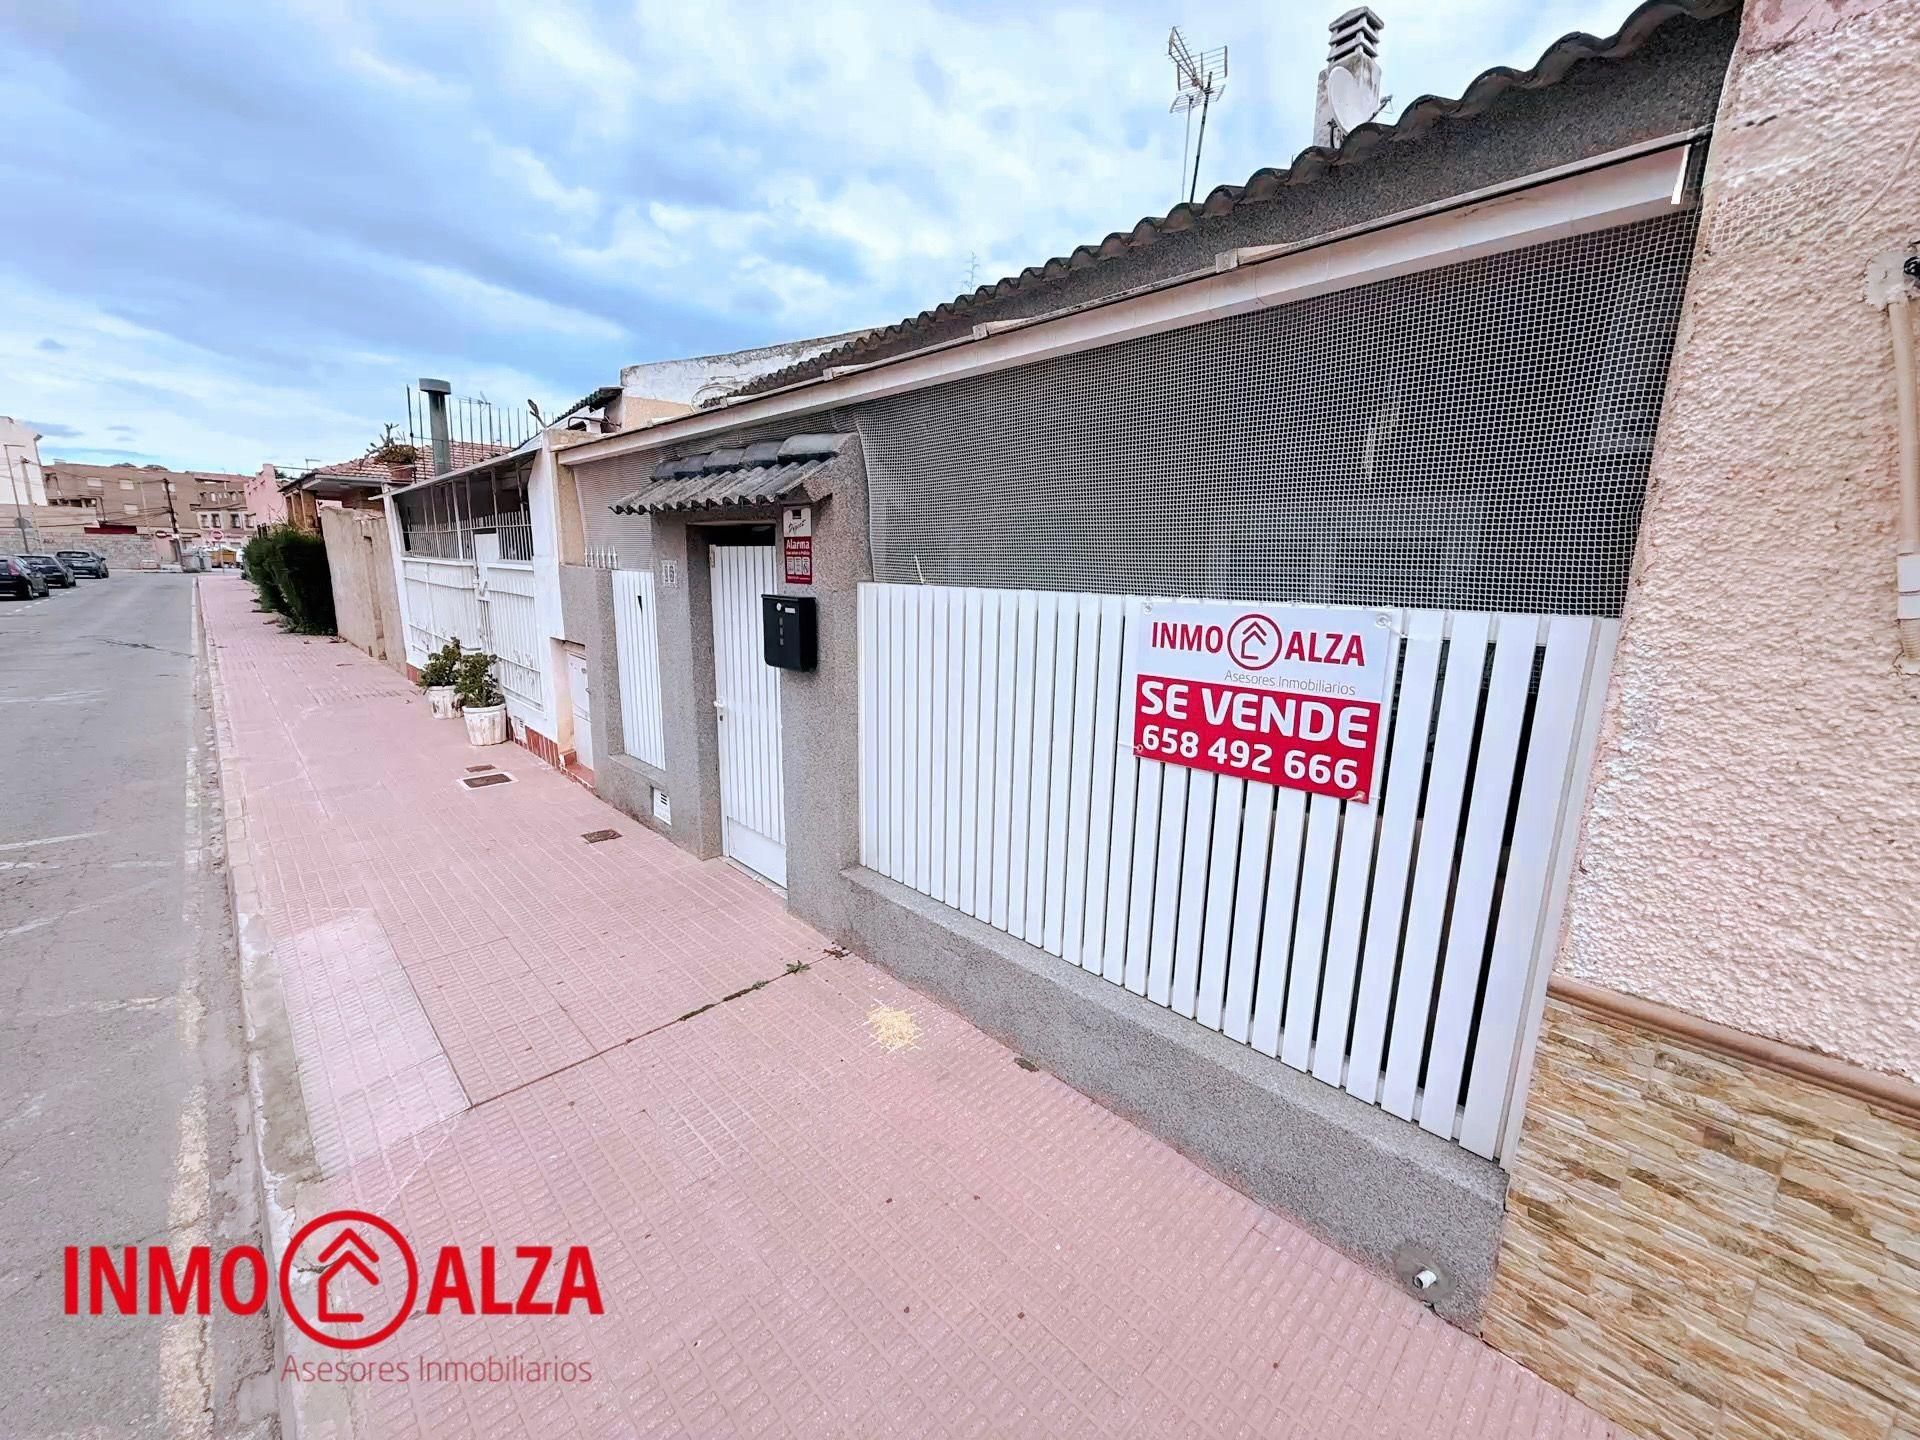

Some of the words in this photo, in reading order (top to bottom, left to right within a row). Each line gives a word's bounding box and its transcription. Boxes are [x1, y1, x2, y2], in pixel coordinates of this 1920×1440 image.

[786, 539, 810, 550] Alarma
[1151, 621, 1223, 654] INMO
[1284, 631, 1365, 667] ALZA
[1224, 670, 1276, 687] Asesores
[1278, 675, 1356, 696] Inmobiliarios
[1141, 680, 1189, 720] SE
[1201, 687, 1370, 749] VENDE
[1142, 724, 1199, 759] 658
[1207, 737, 1273, 773] 492
[1284, 749, 1358, 790] 666
